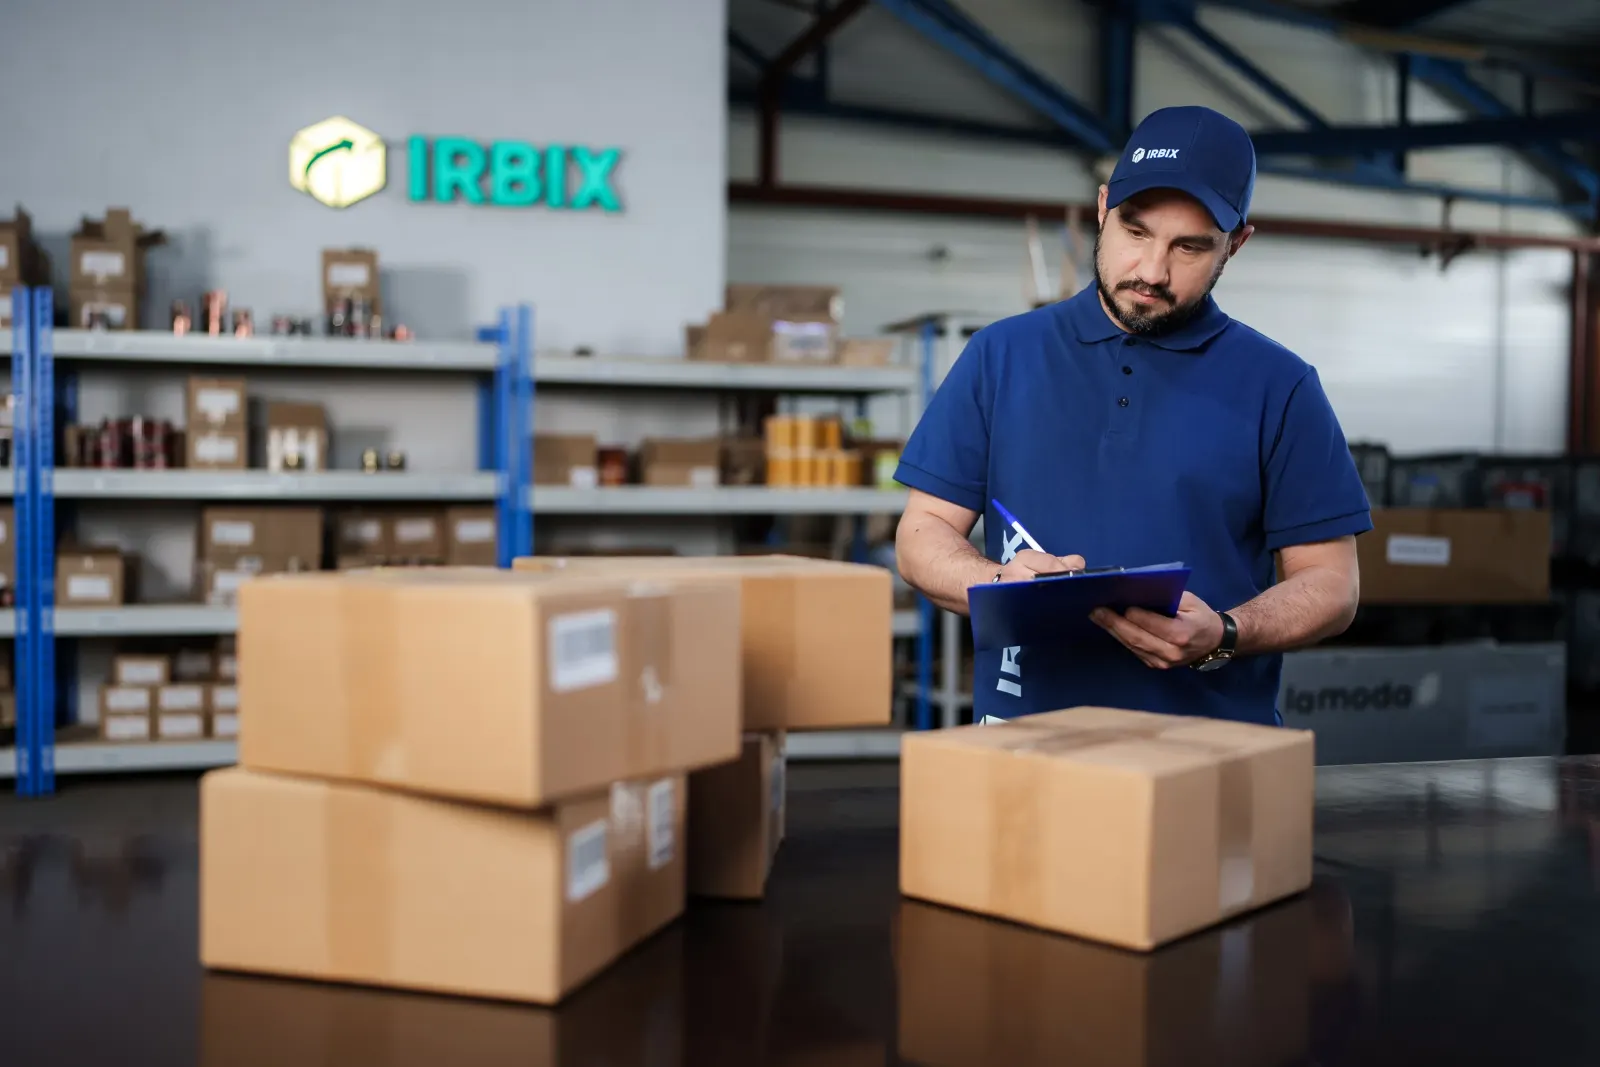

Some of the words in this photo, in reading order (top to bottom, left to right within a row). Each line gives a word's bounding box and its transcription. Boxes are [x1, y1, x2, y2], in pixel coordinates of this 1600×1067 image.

[407, 134, 622, 212] IRBIX
[1146, 148, 1180, 159] IRBIX
[996, 529, 1023, 698] IRX
[1285, 679, 1413, 715] lamoda
